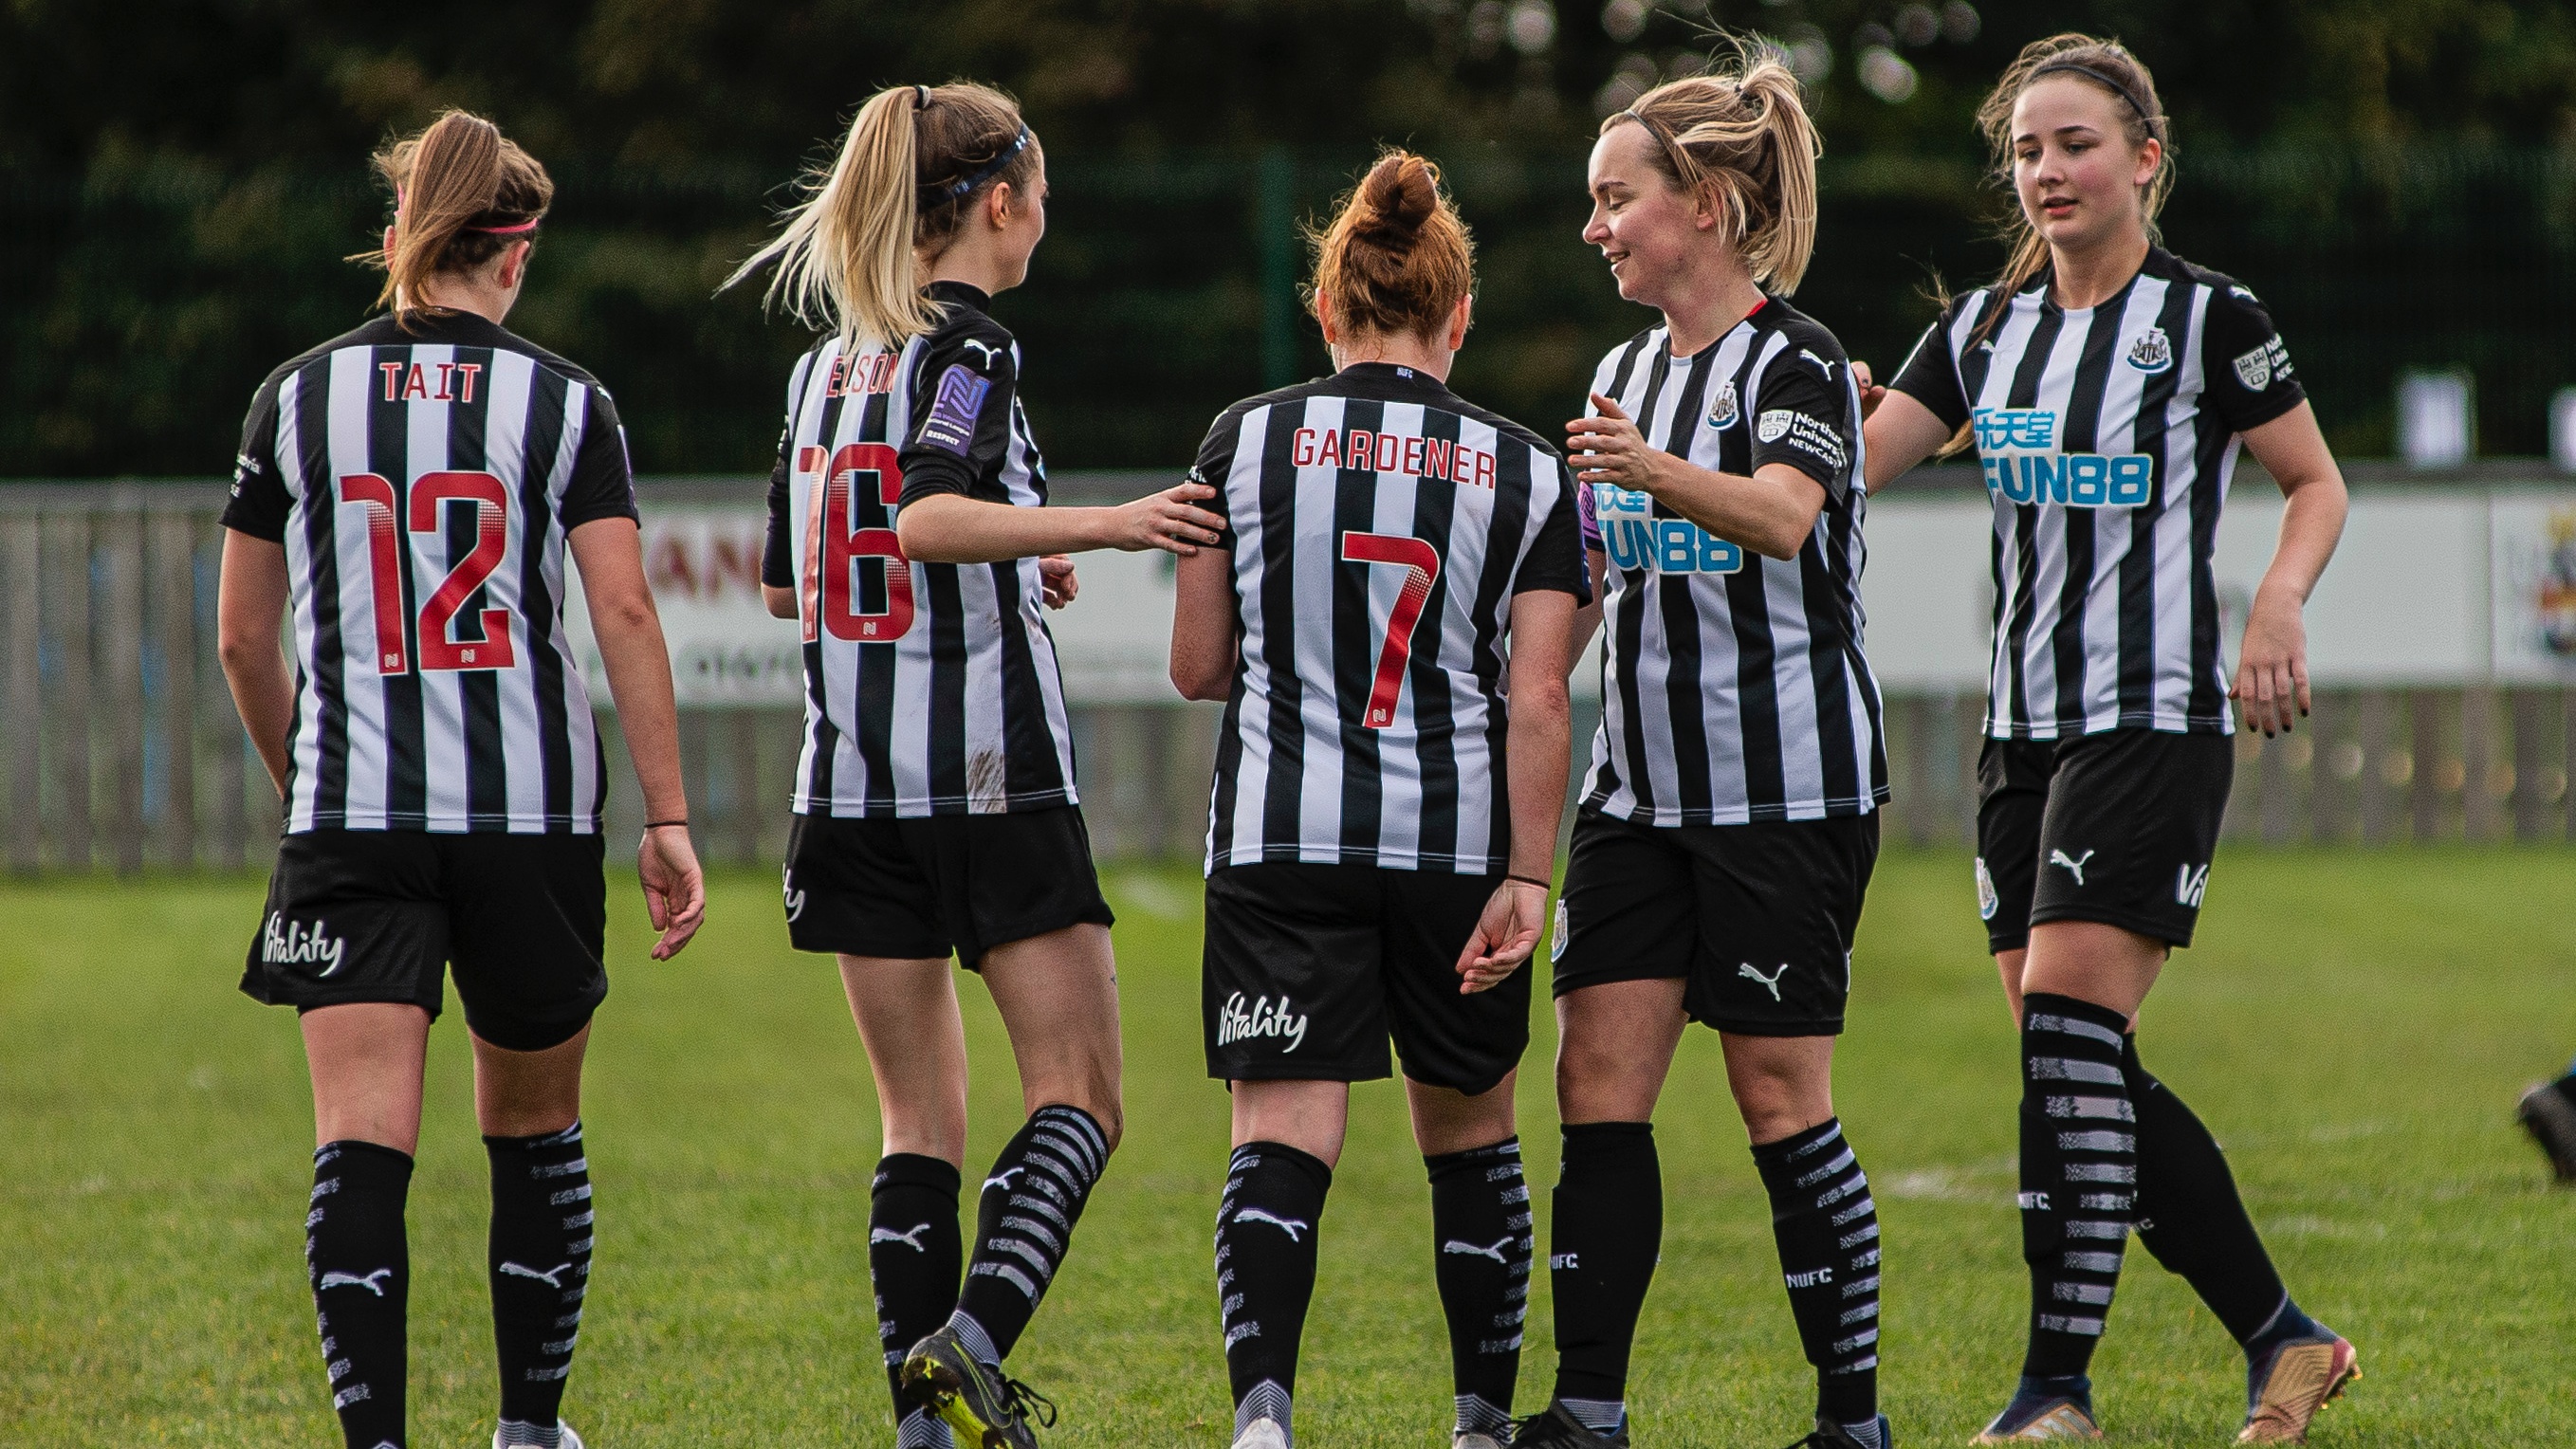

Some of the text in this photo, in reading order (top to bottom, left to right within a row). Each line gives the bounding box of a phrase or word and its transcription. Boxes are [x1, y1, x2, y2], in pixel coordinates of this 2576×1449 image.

[379, 362, 481, 403] TAIT
[1292, 427, 1497, 489] GARDENER
[340, 471, 515, 676] 12
[799, 442, 916, 644] 16
[1341, 531, 1440, 728] 7
[262, 910, 343, 978] Vitality
[1217, 991, 1307, 1054] Vitality
[1786, 1267, 1832, 1288] NUFC
